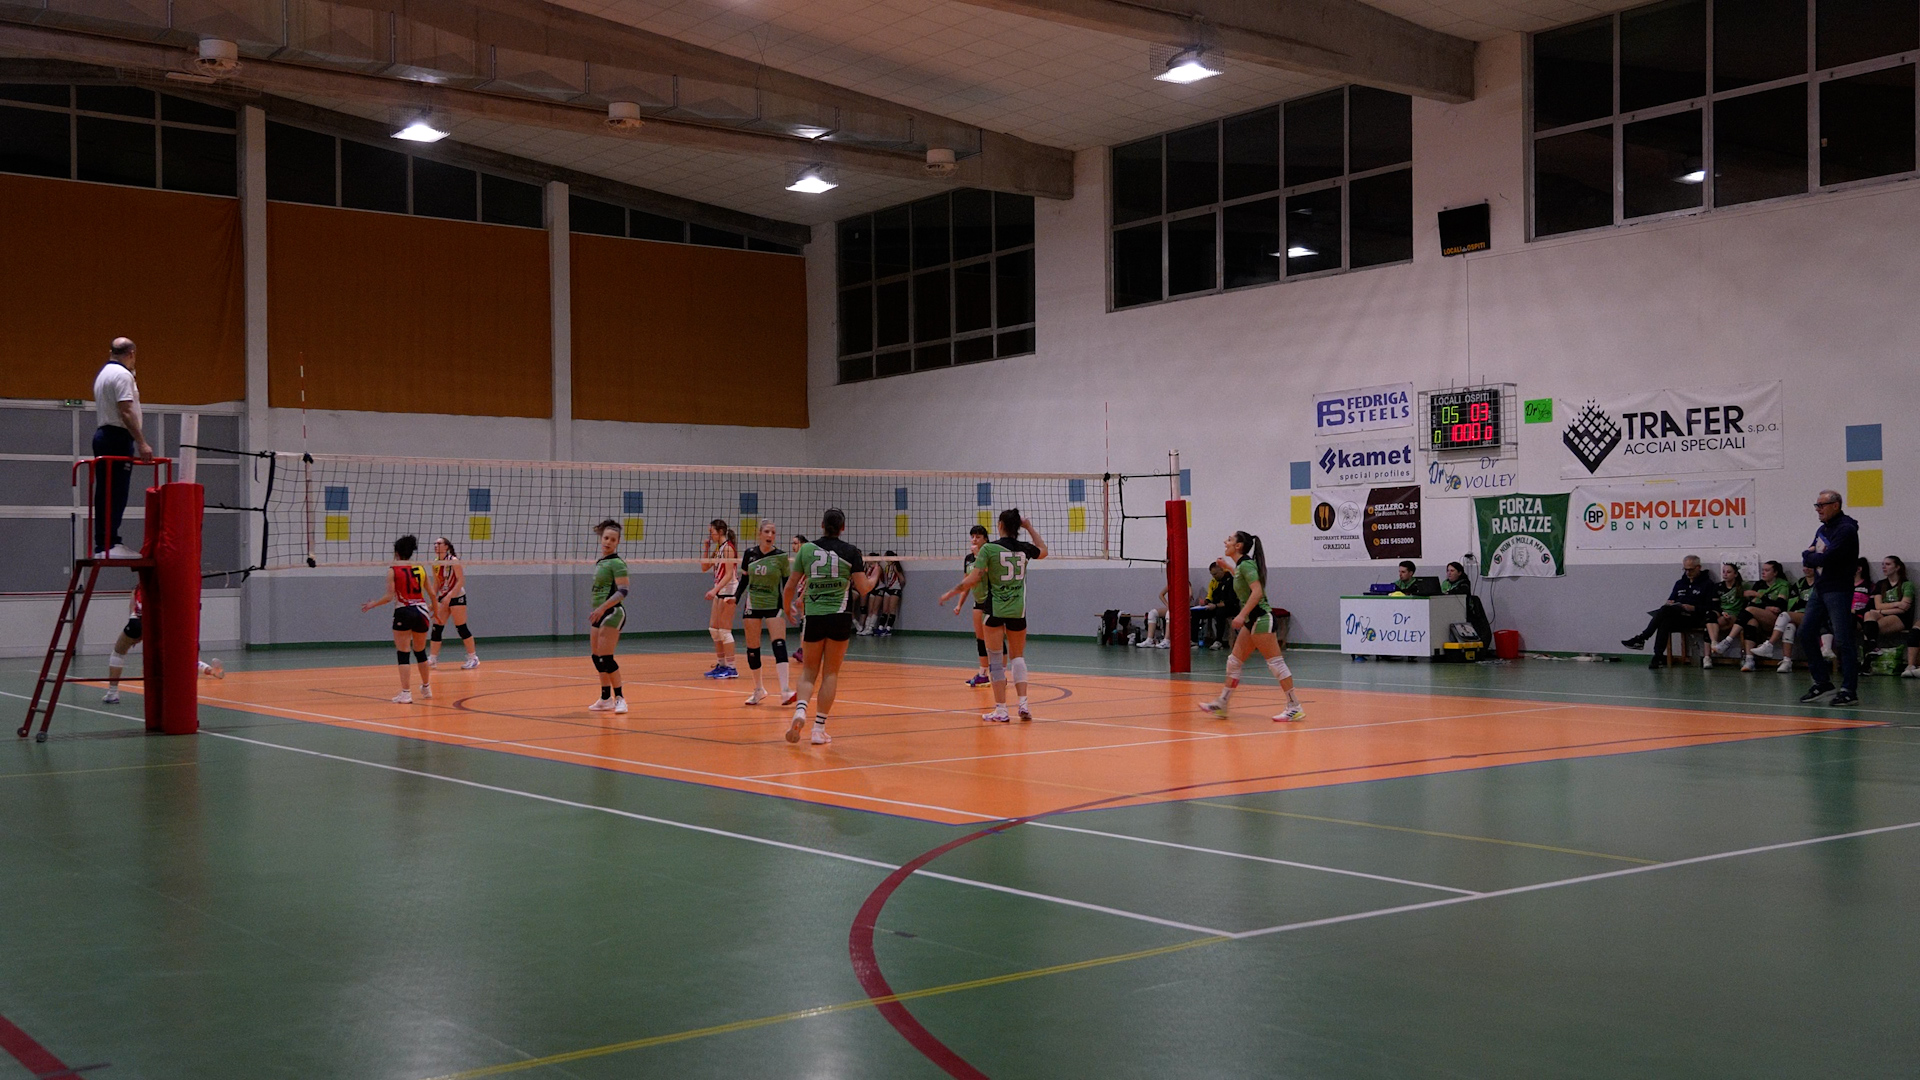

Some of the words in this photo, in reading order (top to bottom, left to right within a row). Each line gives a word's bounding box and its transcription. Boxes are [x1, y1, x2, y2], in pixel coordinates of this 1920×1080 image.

[1347, 391, 1408, 410] FEDRIGA
[1434, 395, 1461, 406] LOCALI
[1464, 392, 1490, 404] OSPITI
[1347, 405, 1409, 424] STEELS
[1441, 405, 1460, 424] 05
[1470, 402, 1489, 422] 03
[1622, 405, 1745, 440] TRAFER
[1747, 422, 1780, 435] s.p.a.
[1434, 430, 1442, 443] 0
[1484, 425, 1493, 440] 0
[1623, 441, 1677, 456] ACCIAI
[1681, 436, 1746, 452] SPECIALI
[1338, 444, 1411, 468] kamet
[1480, 456, 1499, 470] Dr
[1340, 471, 1371, 481] special
[1374, 470, 1410, 479] profiles
[1464, 473, 1516, 489] VOLLEY
[1374, 502, 1405, 512] SELLERO
[1409, 501, 1419, 510] BS
[1499, 498, 1543, 515] FORZA
[1610, 497, 1746, 520] DEMOLIZIONI
[1491, 516, 1552, 534] RAGAZZE
[1588, 510, 1604, 524] BP
[1610, 518, 1747, 532] BONOMELLI
[1515, 536, 1534, 547] MOLLA
[754, 564, 767, 576] 20
[811, 549, 839, 578] 21
[1000, 551, 1026, 581] 53
[402, 567, 422, 594] 15
[1394, 612, 1411, 625] Dr
[1379, 629, 1426, 643] VOLLEY
